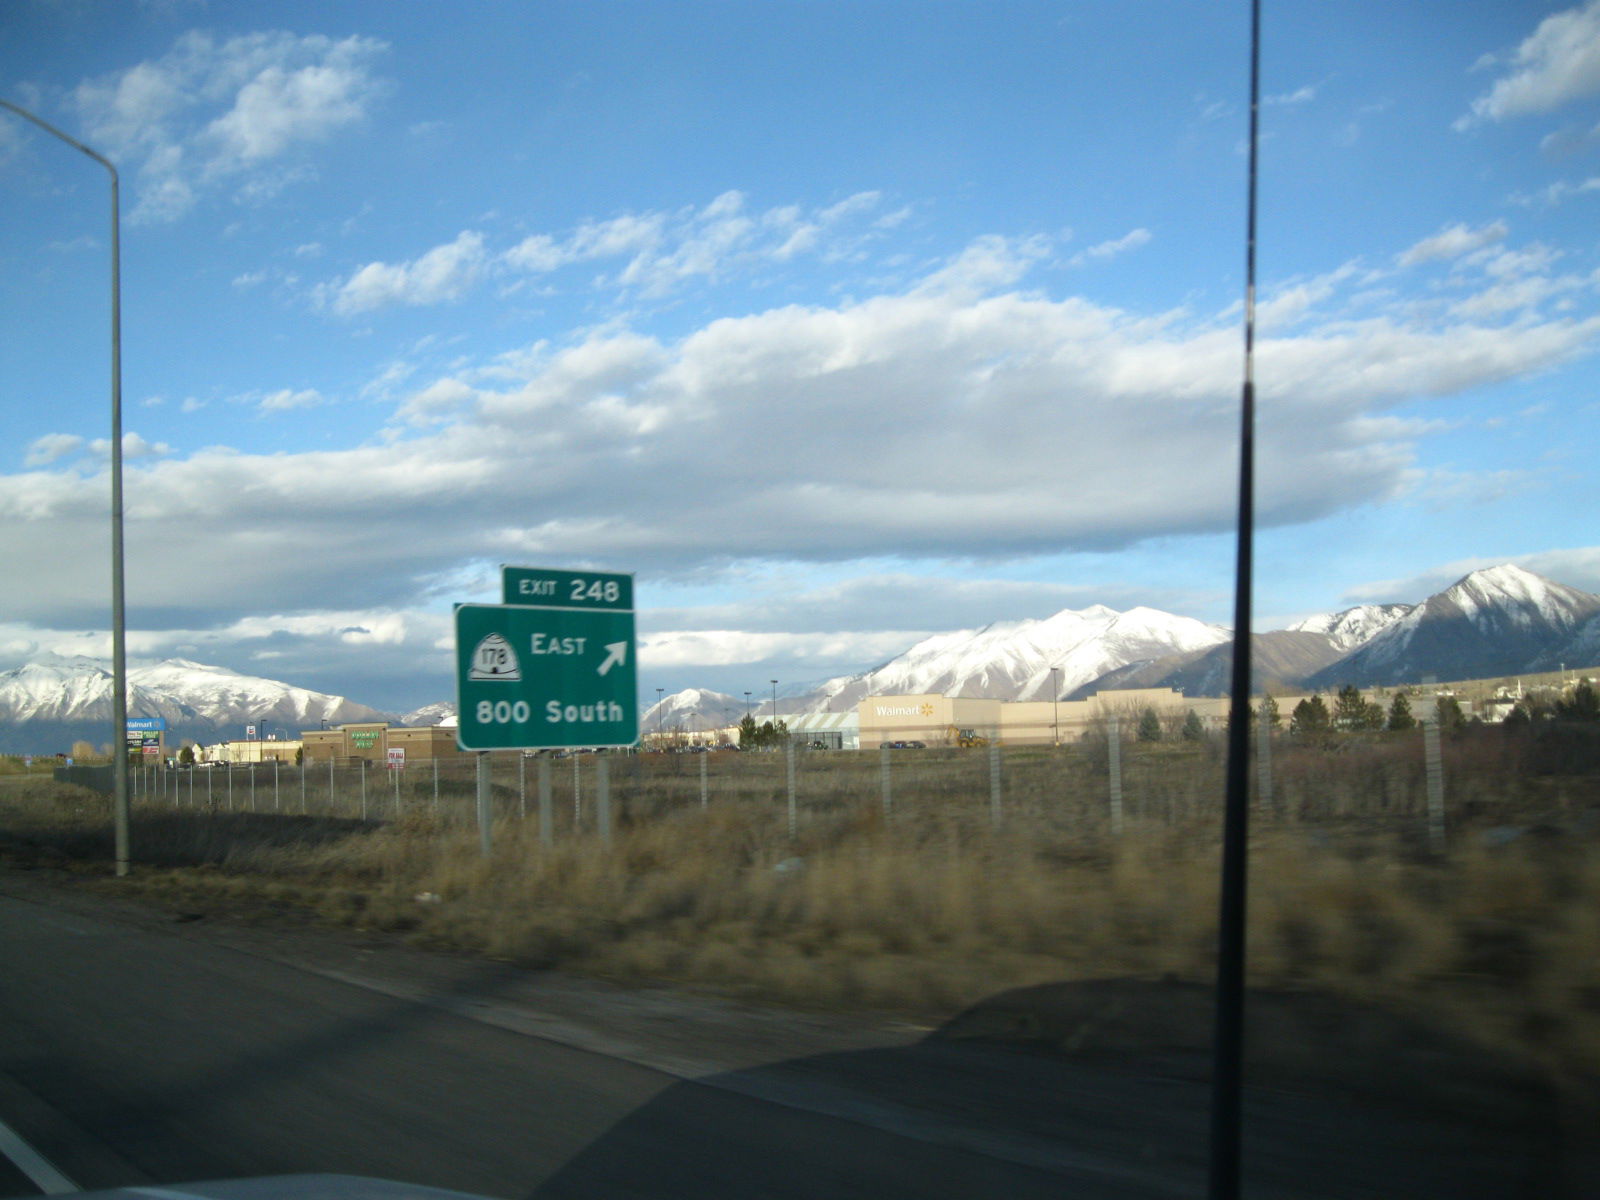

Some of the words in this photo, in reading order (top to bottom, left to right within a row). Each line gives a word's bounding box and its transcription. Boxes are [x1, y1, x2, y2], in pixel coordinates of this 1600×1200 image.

[519, 579, 557, 595] EXIT
[570, 579, 620, 602] 248
[531, 633, 586, 655] EAST
[481, 648, 508, 665] 178
[476, 700, 531, 724] 800
[545, 700, 623, 723] South
[876, 705, 920, 716] Walmart
